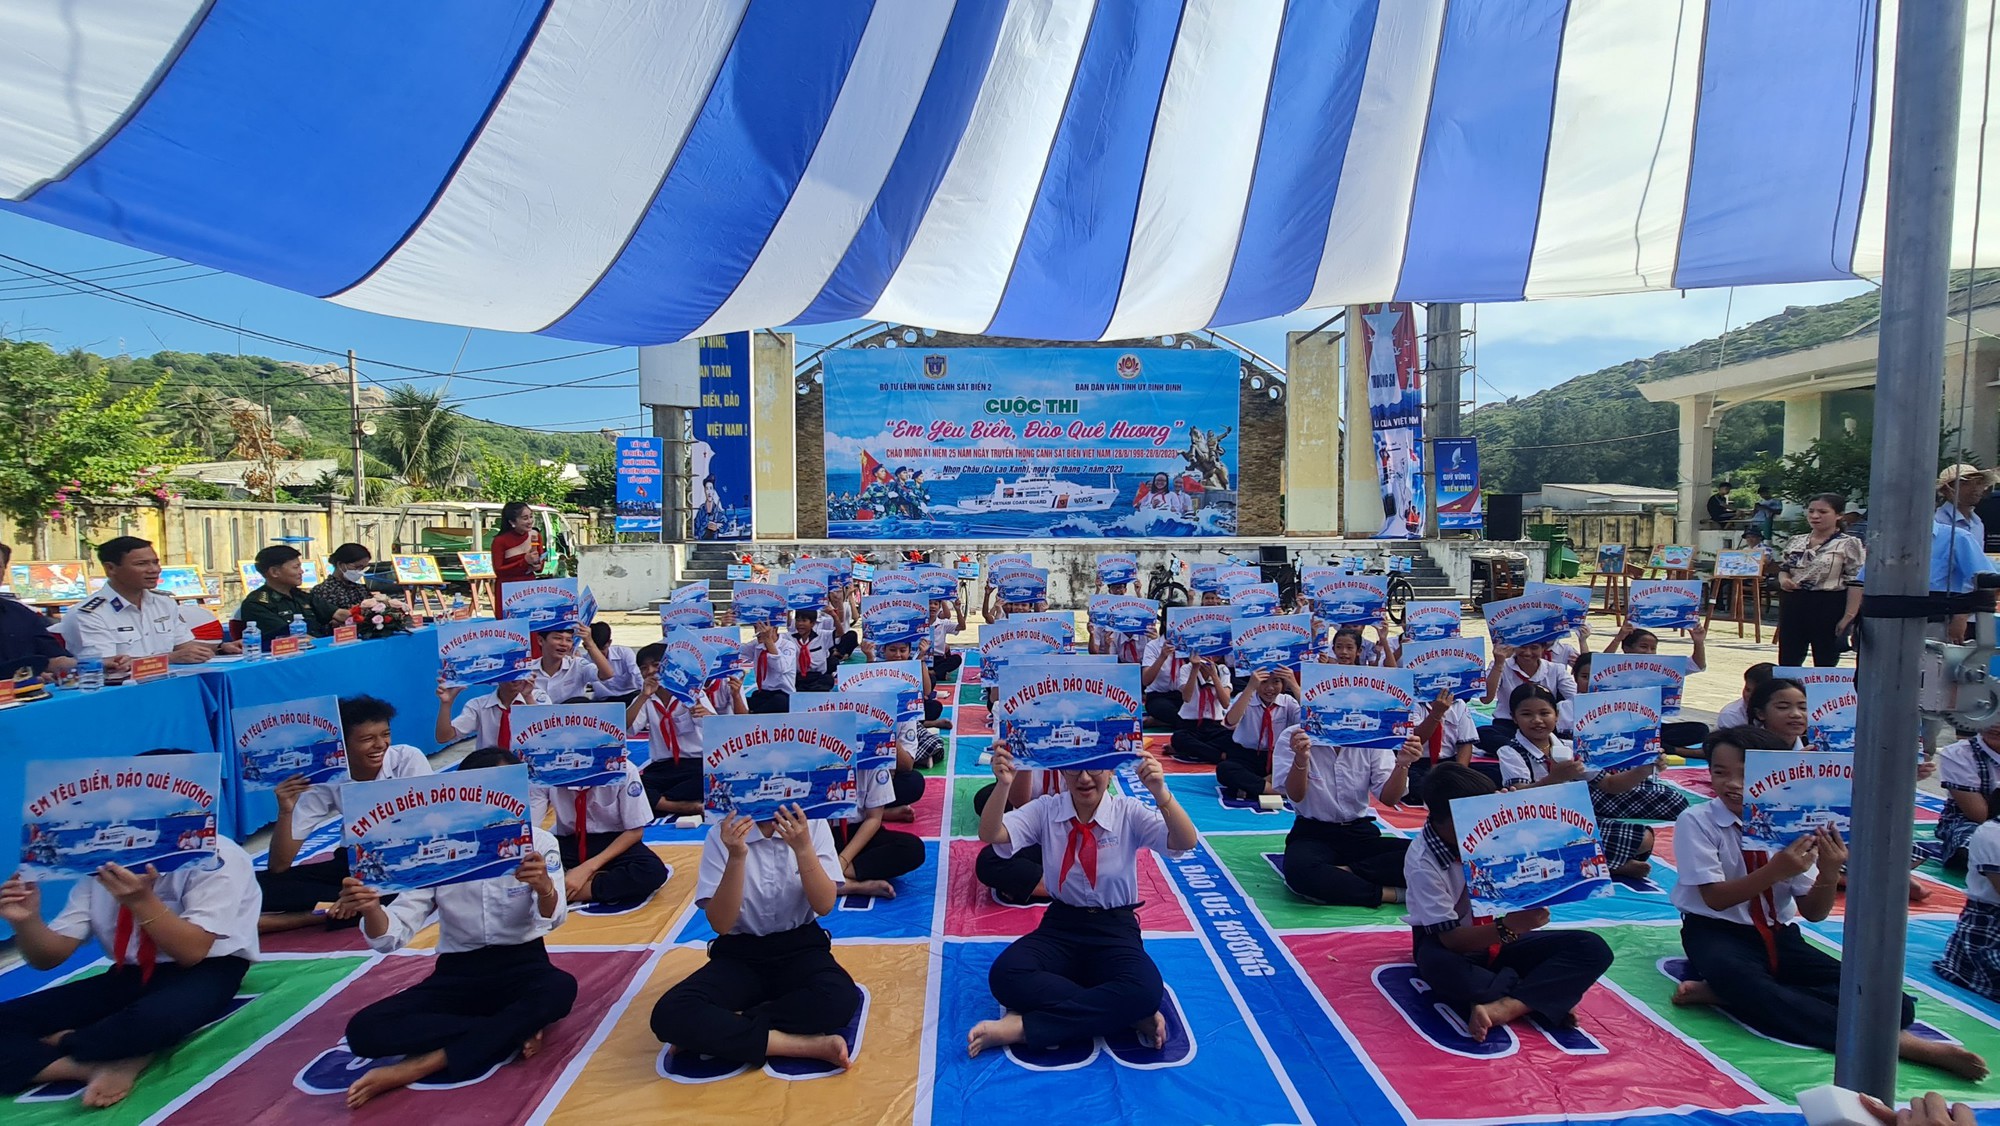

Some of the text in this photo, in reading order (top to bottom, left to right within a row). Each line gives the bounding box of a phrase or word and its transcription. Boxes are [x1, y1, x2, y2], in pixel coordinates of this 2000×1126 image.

[707, 335, 728, 350] NINH,
[711, 362, 732, 378] TOÀN
[702, 389, 740, 408] BIỂN, ĐẢO
[880, 383, 889, 392] BỘ
[890, 382, 900, 391] TƯ
[900, 382, 917, 392] LỆNH
[936, 381, 955, 391] CẢNH
[956, 381, 969, 391] SÁT
[971, 380, 986, 391] BIỂN
[987, 383, 992, 391] 2
[985, 396, 1078, 416] CUỘC THI
[706, 421, 723, 439] VIỆT
[724, 423, 743, 436] NAM
[927, 420, 965, 441] Yêu
[970, 419, 1016, 440] Biển,
[1024, 420, 1063, 439] Đảo
[1067, 420, 1105, 440] Quê
[886, 447, 903, 458] CHÀO
[904, 446, 922, 458] MỪNG
[932, 448, 947, 459] NIỆM
[949, 449, 957, 458] 25
[958, 447, 972, 458] NĂM
[973, 447, 990, 458] NGÀY
[991, 446, 1014, 458] TRUYỀN
[1015, 446, 1035, 458] THỐNG
[1036, 447, 1053, 458] CẢNH
[1054, 447, 1066, 458] SÁT
[1067, 446, 1081, 458] BIỂN
[1083, 448, 1095, 459] VIỆT
[1096, 448, 1111, 458] NAM
[943, 465, 961, 473] Nhơn
[962, 465, 980, 473] Châu
[1032, 465, 1050, 474] ngày
[1061, 465, 1081, 474] tháng
[1088, 465, 1104, 473] năm
[1105, 465, 1124, 473] 2023
[441, 625, 529, 656] EM YÊU BIỂN, ĐẢO QUÊ HƯƠNG
[840, 666, 921, 693] EM YÊU BIỂN, ĐẢO QUÊ HƯƠNG
[1004, 673, 1138, 715] EM YÊU BIỂN, ĐẢO QUÊ HƯƠNG
[1305, 672, 1413, 707] EM YÊU BIỂN, ĐẢO QUÊ HƯƠNG
[240, 708, 339, 748] EM YÊU BIỂN, ĐẢO QUÊ HƯƠNG
[516, 712, 625, 745] EM YÊU BIỂN, ĐẢO QUÊ HƯƠNG
[707, 723, 853, 769] EM YÊU BIỂN, ĐẢO QUÊ HƯƠNG
[29, 767, 213, 817] EM YÊU BIỂN, ĐẢO QUÊ HƯƠNG
[1749, 781, 1766, 799] EM
[1765, 768, 1787, 788] YÊU
[1789, 760, 1815, 781] BIỂN,
[1819, 760, 1841, 778] ĐẢO
[352, 783, 526, 838] EM YÊU BIỂN, ĐẢO QUÊ HƯƠNG
[1462, 800, 1594, 855] EM YÊU BIỂN, ĐẢO QUÊ HƯƠNG
[1178, 864, 1220, 890] ĐẢO
[1212, 920, 1276, 977] HƯƠNG
